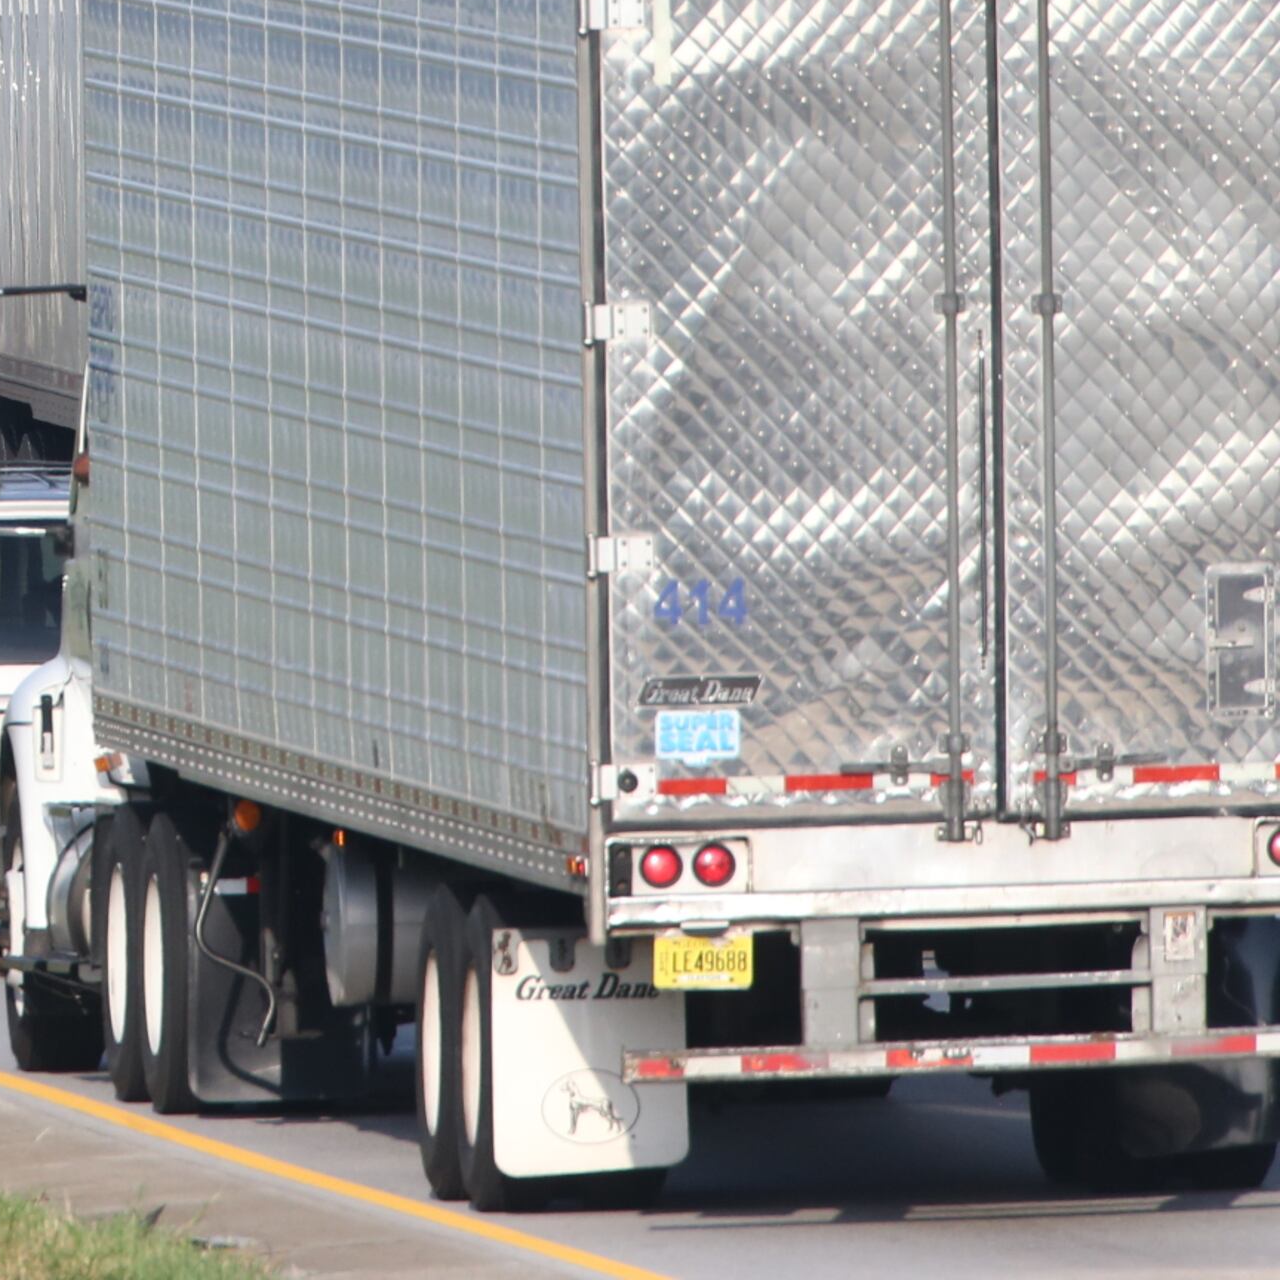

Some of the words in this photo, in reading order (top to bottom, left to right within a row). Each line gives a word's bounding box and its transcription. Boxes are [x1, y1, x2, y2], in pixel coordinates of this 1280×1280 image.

[653, 575, 749, 626] 414
[645, 680, 699, 704] Great
[701, 679, 755, 703] Dane
[659, 713, 734, 731] SUPER
[659, 731, 736, 753] SEAL
[514, 974, 590, 1001] Great
[593, 972, 661, 1001] Dane
